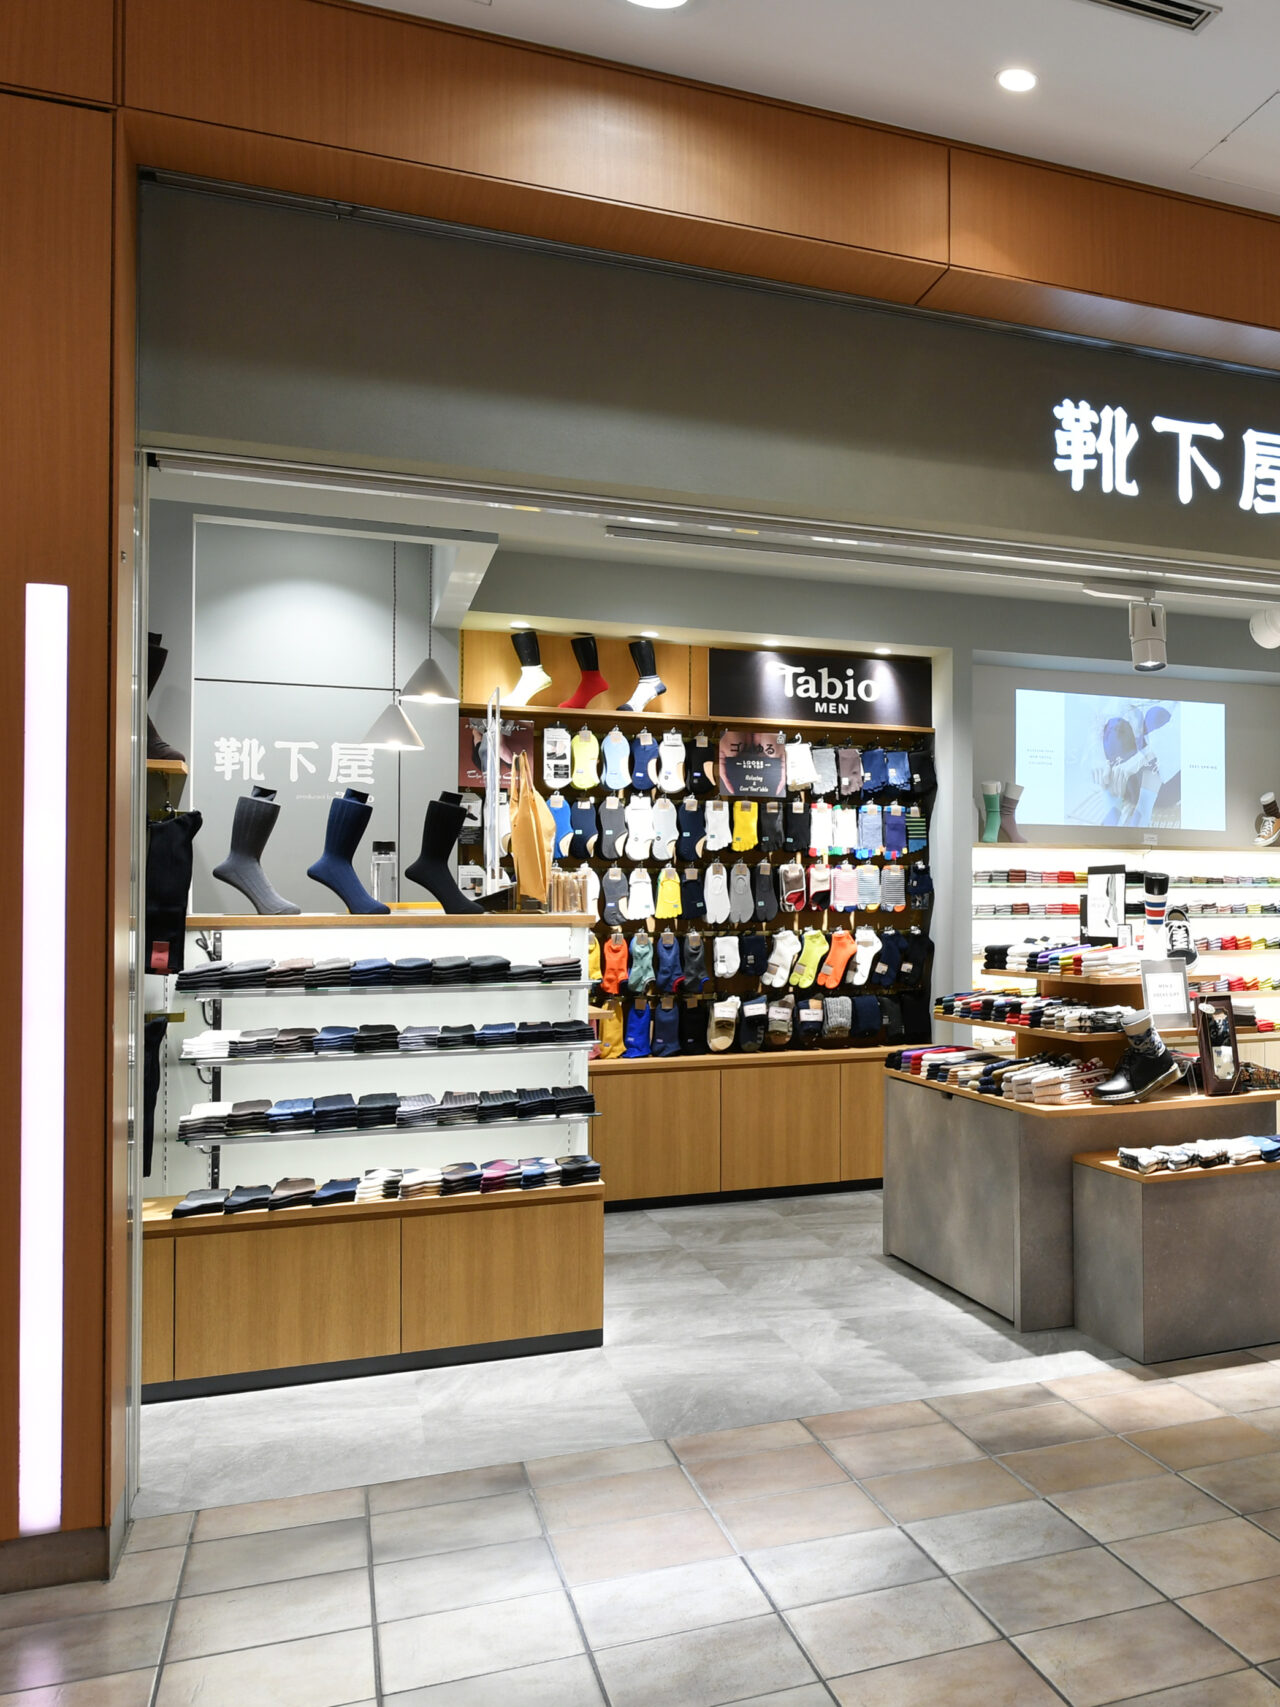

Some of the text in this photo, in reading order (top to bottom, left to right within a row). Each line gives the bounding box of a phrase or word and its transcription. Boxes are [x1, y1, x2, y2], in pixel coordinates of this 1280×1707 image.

[766, 661, 882, 702] Tabio
[815, 702, 849, 715] MEN
[214, 736, 376, 785] 靴下屋
